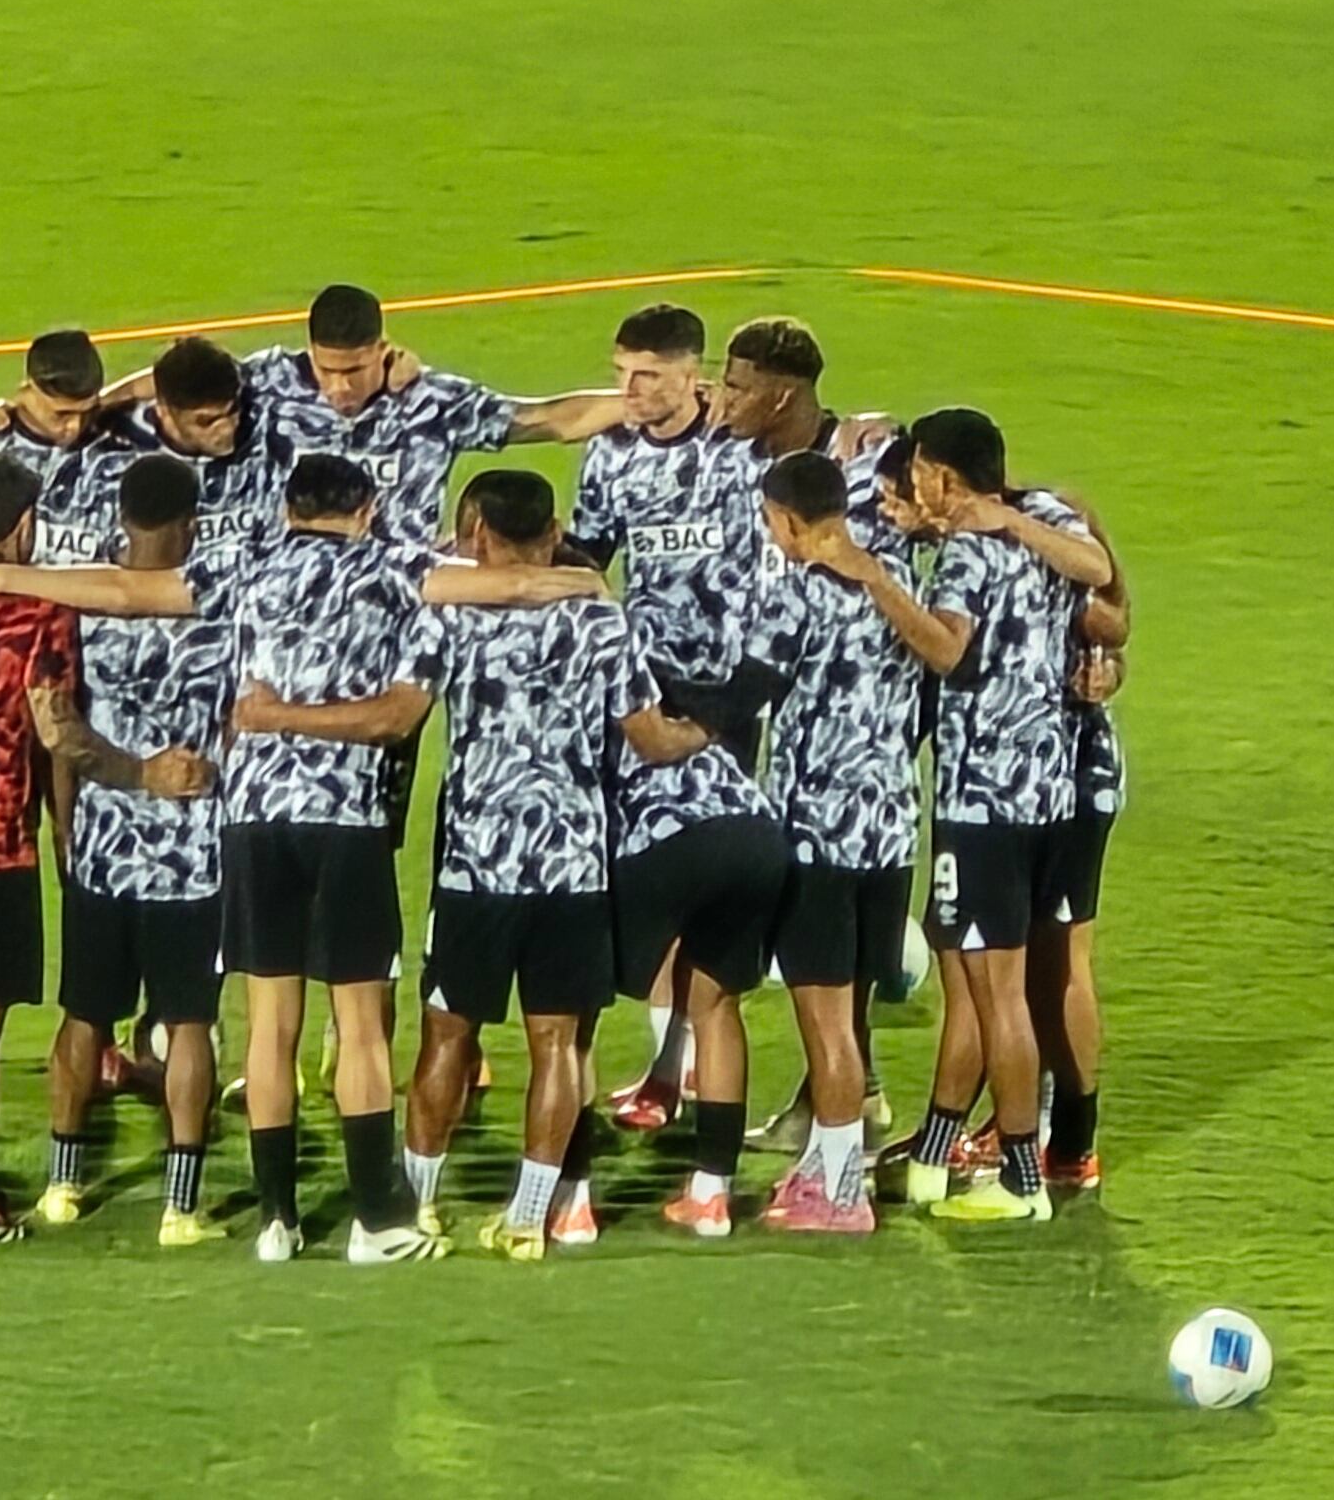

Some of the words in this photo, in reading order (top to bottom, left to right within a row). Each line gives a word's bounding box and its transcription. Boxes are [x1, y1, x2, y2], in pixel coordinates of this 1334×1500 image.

[198, 507, 255, 542] BAC
[662, 526, 722, 551] BAC
[934, 852, 959, 901] 9
